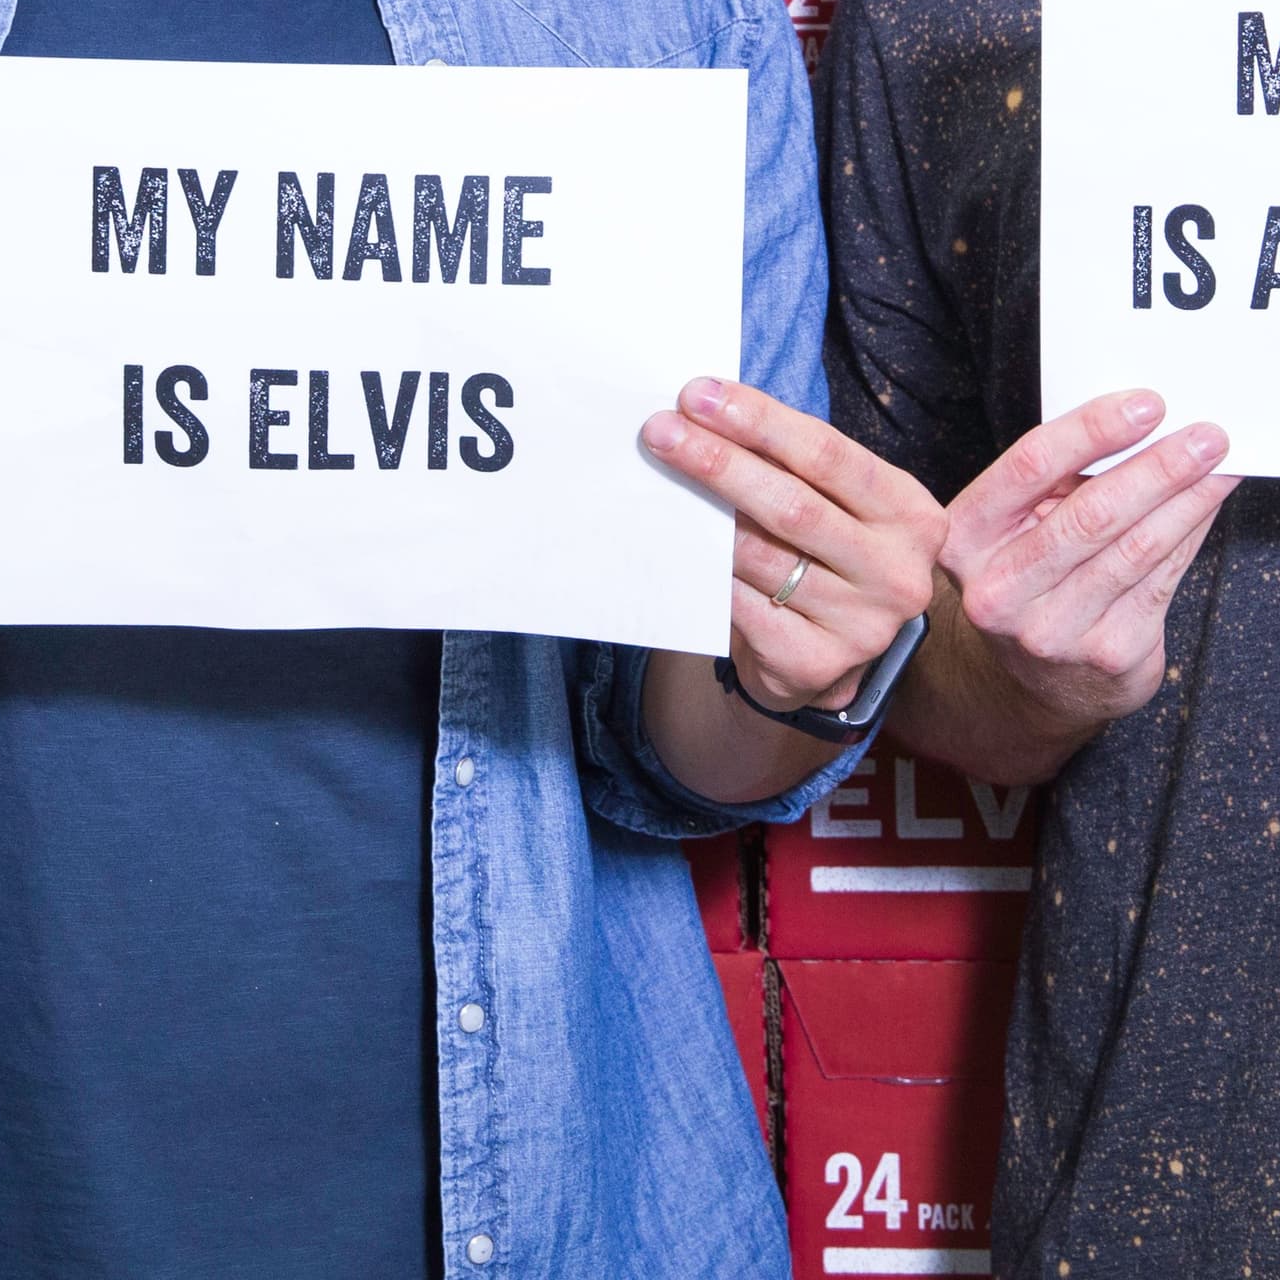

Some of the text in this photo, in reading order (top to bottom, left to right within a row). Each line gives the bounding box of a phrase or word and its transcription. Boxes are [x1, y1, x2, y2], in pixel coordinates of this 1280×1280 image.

[92, 166, 552, 285] MY NAME
[1133, 204, 1216, 310] IS
[124, 365, 514, 472] IS ELVIS
[826, 1153, 975, 1231] 24 PACK
